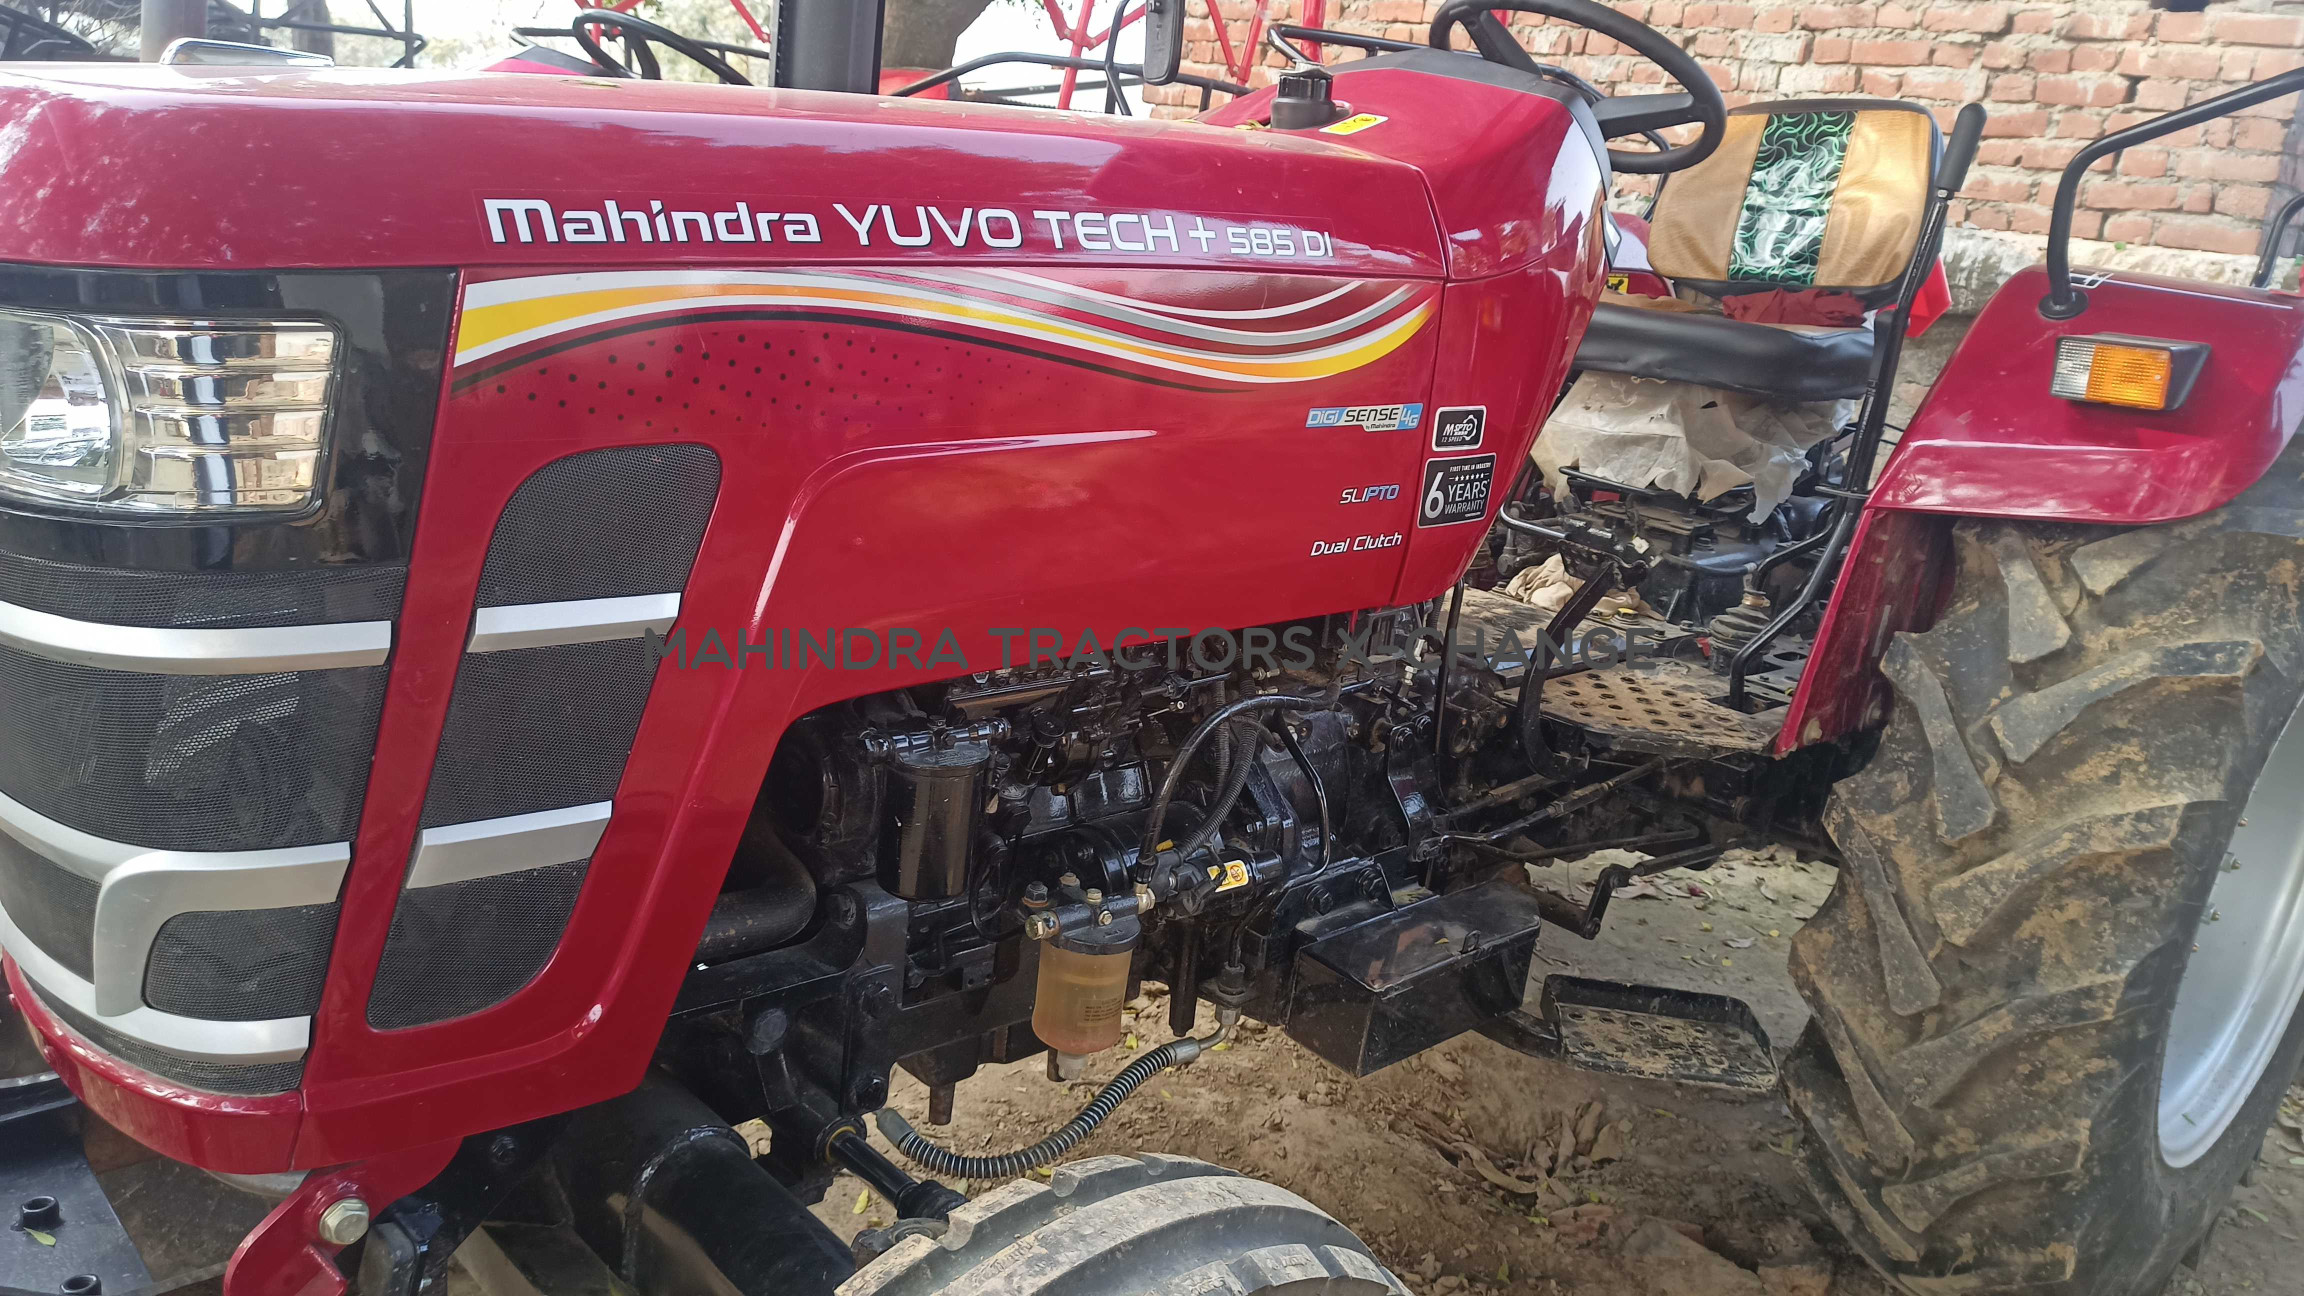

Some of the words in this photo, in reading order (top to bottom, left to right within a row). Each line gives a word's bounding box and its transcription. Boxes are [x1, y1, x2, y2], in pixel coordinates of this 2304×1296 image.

[483, 198, 821, 243] Mahindra
[832, 203, 1022, 248] YUVO
[1227, 227, 1296, 256] 585
[1304, 230, 1334, 257] DI
[1401, 407, 1419, 427] 4G
[1425, 471, 1445, 519] 6
[1444, 499, 1485, 515] WARRANTY
[1311, 537, 1351, 556] Dual
[1353, 531, 1402, 551] Clutch
